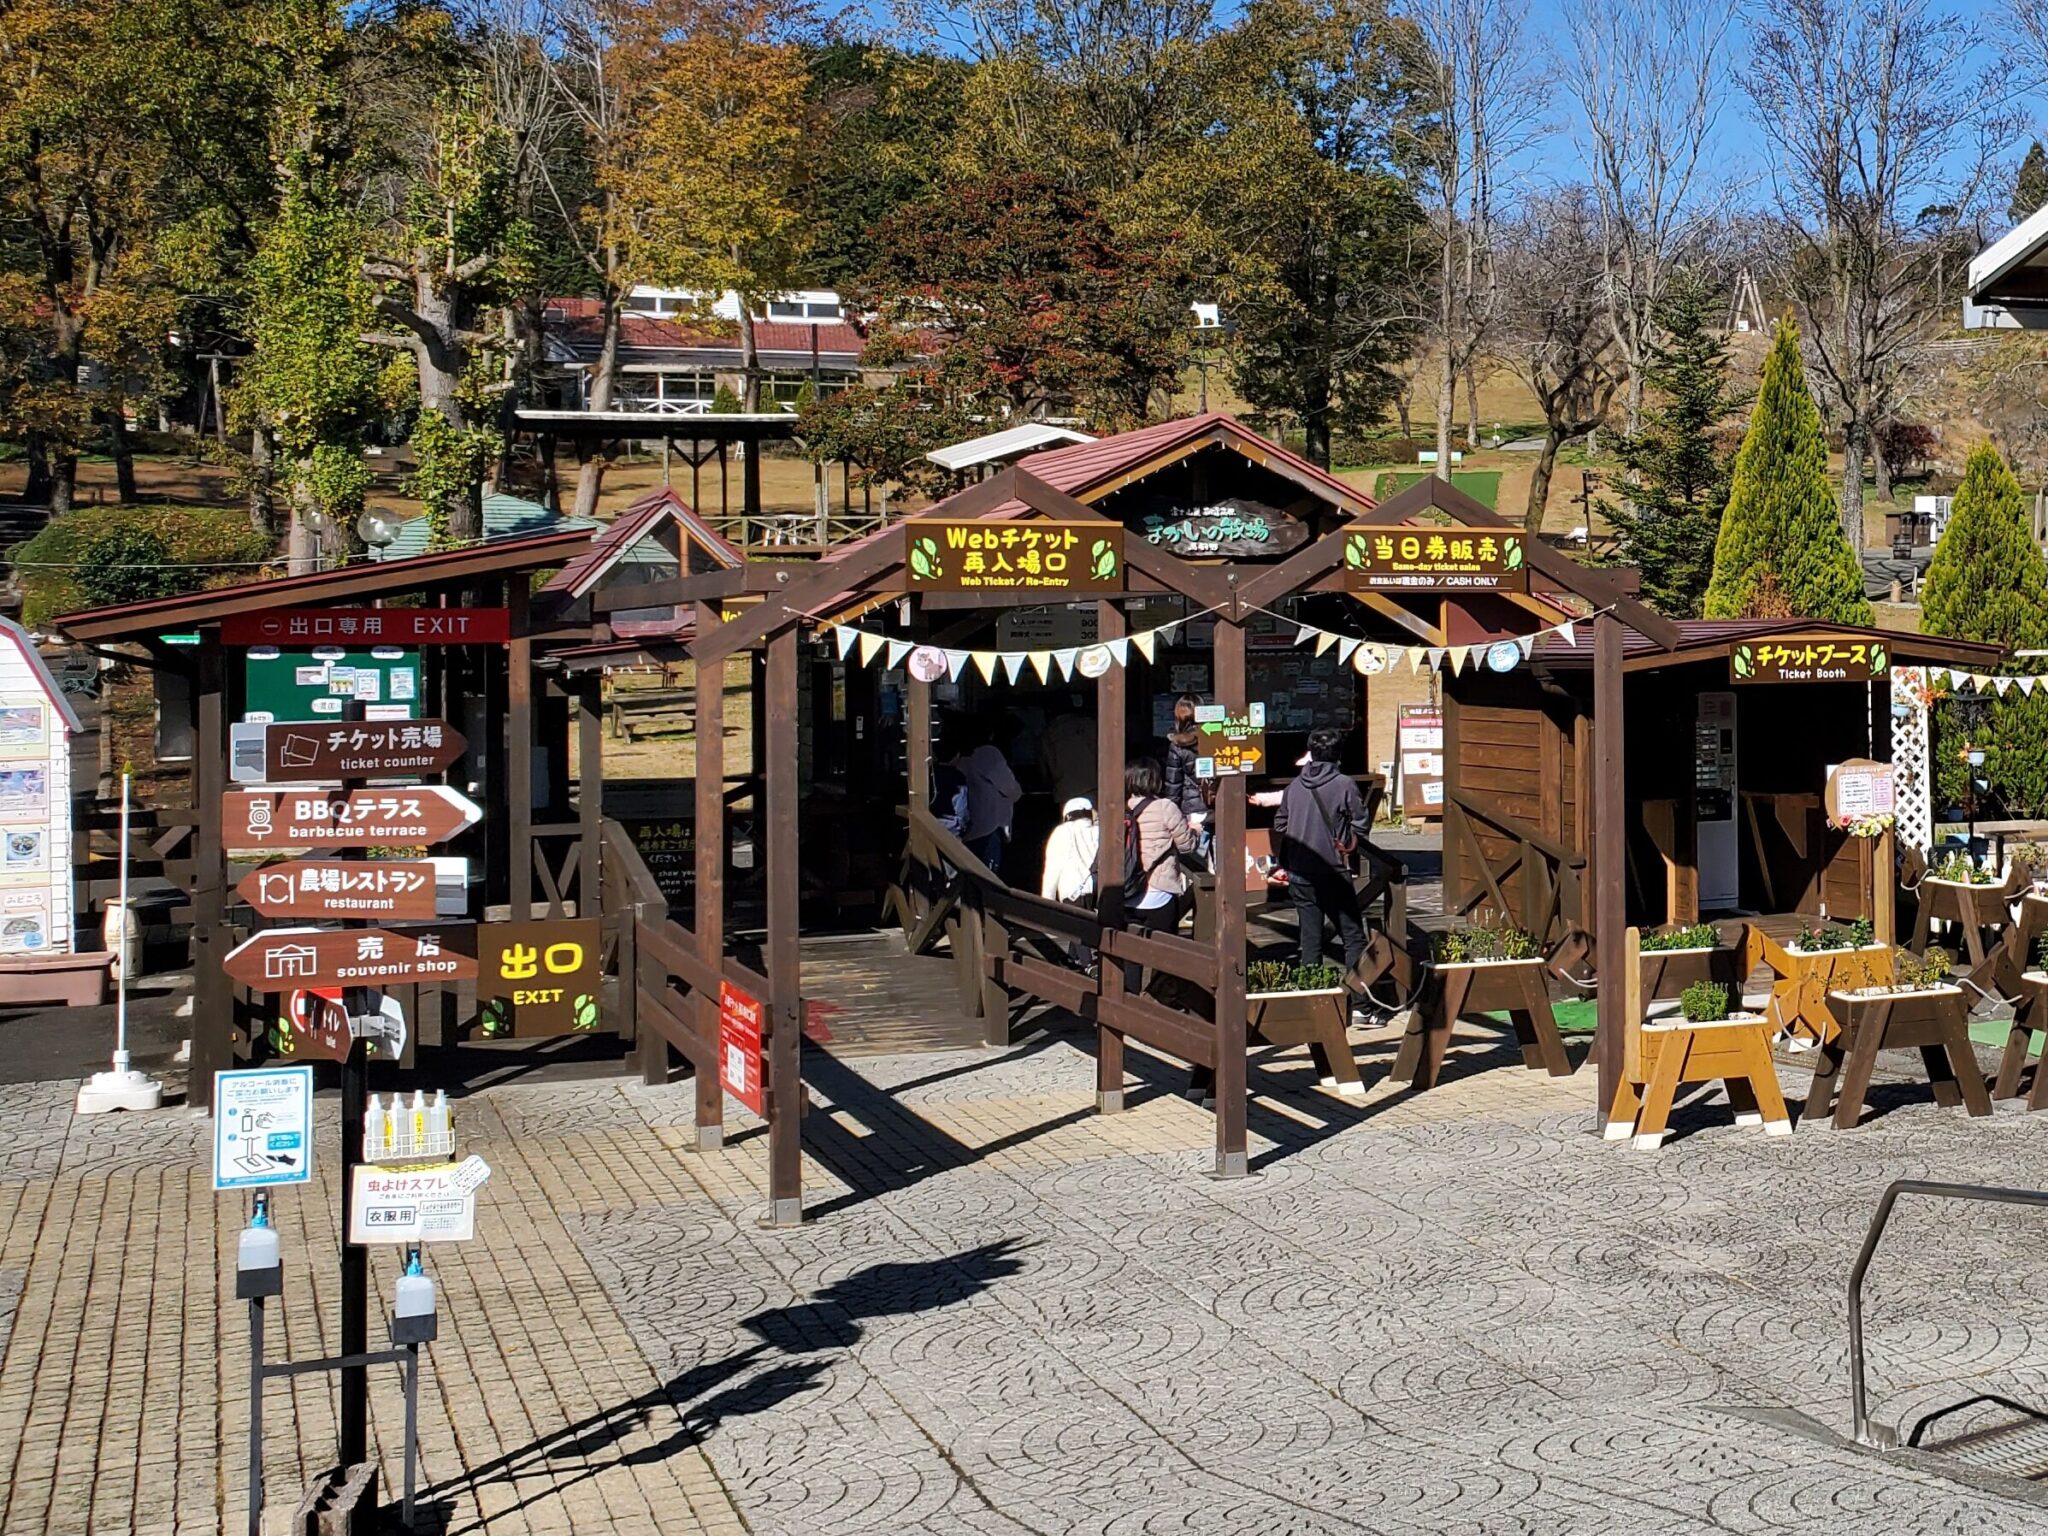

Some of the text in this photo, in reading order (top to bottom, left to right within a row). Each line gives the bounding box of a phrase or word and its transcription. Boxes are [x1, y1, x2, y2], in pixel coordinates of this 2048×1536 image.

[1143, 514, 1270, 545] まかいの牧場
[946, 528, 1079, 550] Webチケット
[1374, 535, 1499, 562] 当日券販売
[962, 550, 1067, 574] 再入場口
[1392, 562, 1433, 572] Same-day
[1434, 562, 1459, 571] ticket
[960, 577, 982, 587] Web
[983, 577, 1015, 587] Ticket
[1026, 577, 1069, 588] Re-Entry
[1446, 577, 1498, 586] CASH ONLY
[289, 617, 383, 635] 出口専用
[413, 617, 470, 634] EXIT
[1756, 644, 1867, 667] チケットブース
[1778, 668, 1847, 679] Ticket Booth
[326, 726, 443, 751] チケット売場
[1222, 726, 1263, 737] WEBチケット
[340, 755, 435, 770] ticket counter
[294, 798, 423, 823] BBQテラス
[288, 824, 427, 838] barbecue terrace
[300, 868, 425, 893] 農場レストラン
[324, 897, 395, 910] restaurant
[336, 960, 457, 978] souvenir shop
[500, 942, 583, 979] 出口
[513, 988, 565, 1006] EXIT
[367, 1177, 449, 1192] 虫よけスプレ
[369, 1210, 413, 1222] 衣服用
